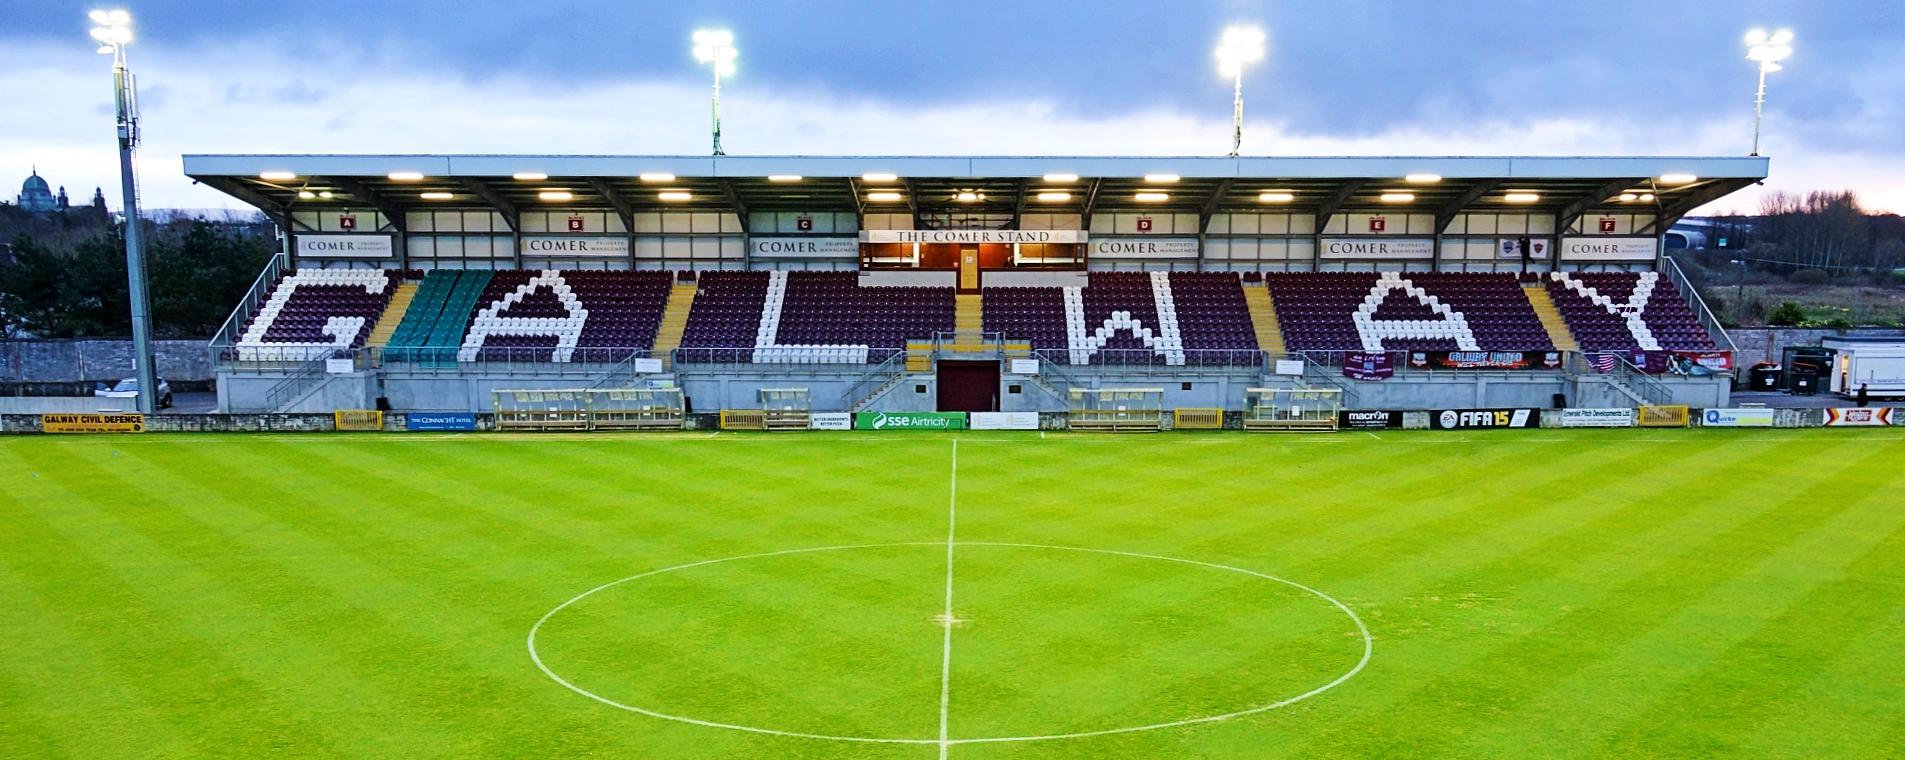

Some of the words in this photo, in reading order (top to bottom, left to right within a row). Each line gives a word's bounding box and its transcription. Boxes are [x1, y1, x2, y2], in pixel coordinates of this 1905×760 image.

[896, 231, 928, 242] THE
[934, 231, 992, 242] COMER
[997, 231, 1050, 242] STAND
[308, 241, 354, 250] COMER
[530, 240, 588, 251] COMER
[759, 241, 817, 252] COMER
[1099, 242, 1157, 253] COMER
[1330, 243, 1388, 254] COMER
[1572, 245, 1618, 253] COMER
[1448, 351, 1489, 361] GALWAY
[1490, 352, 1523, 362] UNITED
[44, 415, 78, 423] GALWAY
[81, 415, 102, 423] CIVIL
[105, 415, 142, 423] DEFENCE
[421, 416, 456, 424] CONNACHT
[1349, 411, 1389, 420] macron
[1460, 411, 1493, 427] FIFA
[1493, 411, 1509, 426] 15
[1706, 410, 1737, 424] Quirke
[887, 416, 910, 427] sse
[911, 417, 950, 428] Airtricity
